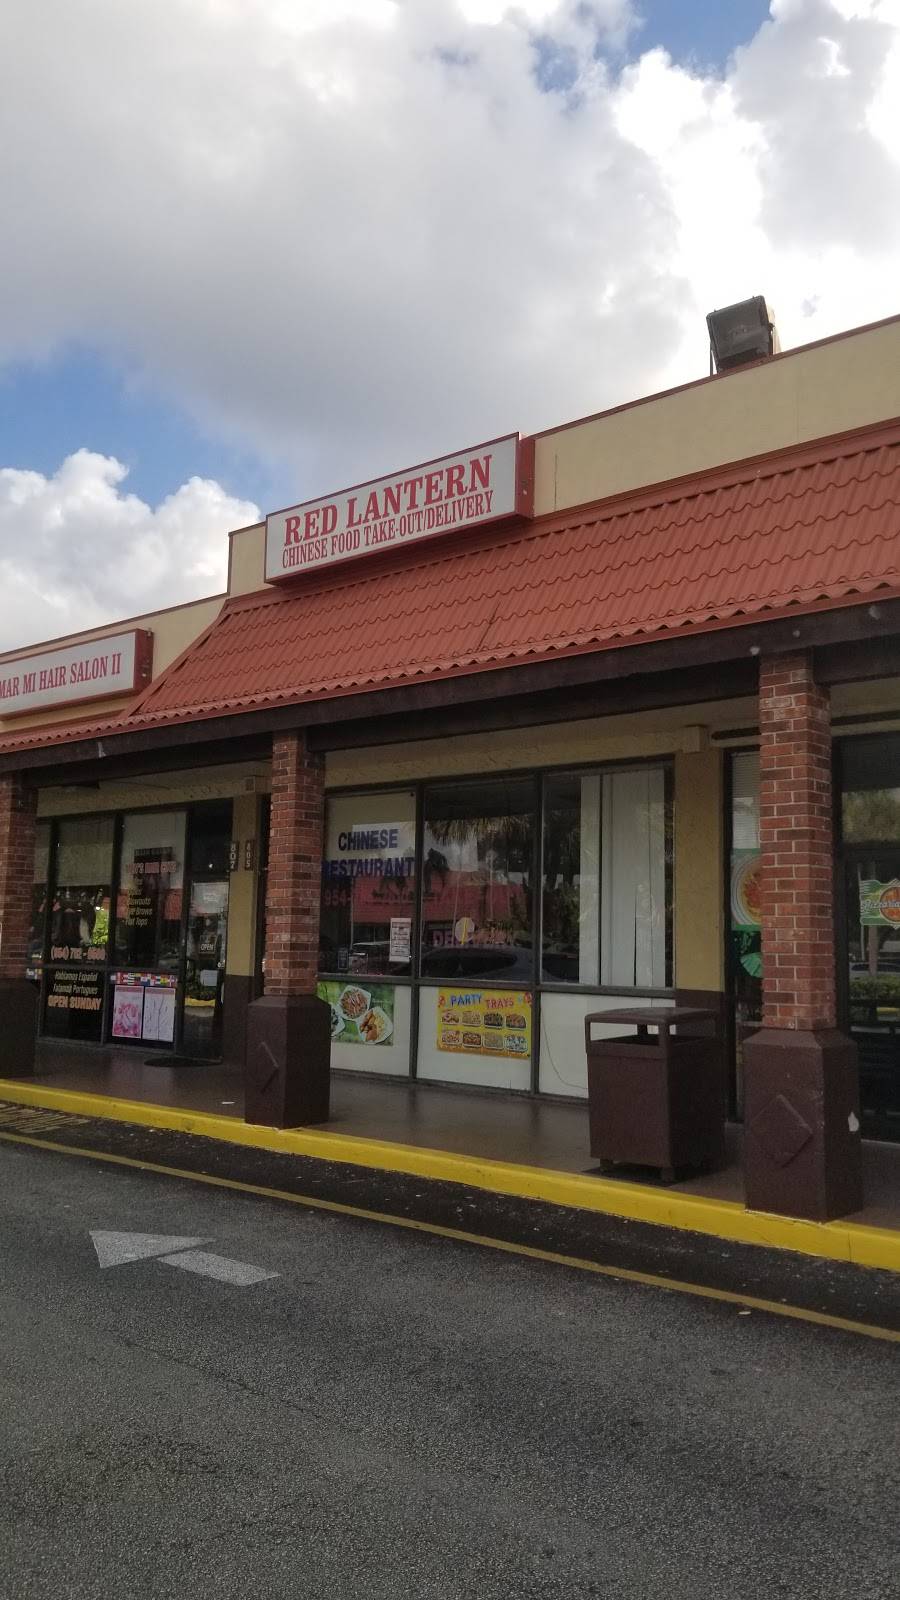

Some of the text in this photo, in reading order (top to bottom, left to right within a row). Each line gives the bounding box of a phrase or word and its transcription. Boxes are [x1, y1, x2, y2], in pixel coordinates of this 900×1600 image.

[284, 455, 492, 547] RED LANTERN
[282, 490, 493, 569] CHINESE FOOD TAKE-OUT/DELIVERY
[23, 672, 37, 694] MI
[39, 666, 67, 691] HAIR
[70, 656, 109, 684] SALON
[112, 653, 122, 675] II
[338, 829, 399, 851] CHINESE
[321, 857, 415, 880] RESTAURANT
[200, 943, 214, 951] OPEN
[48, 995, 102, 1010] OPEN SUNDAY
[450, 993, 514, 1009] PARTY TRAYS
